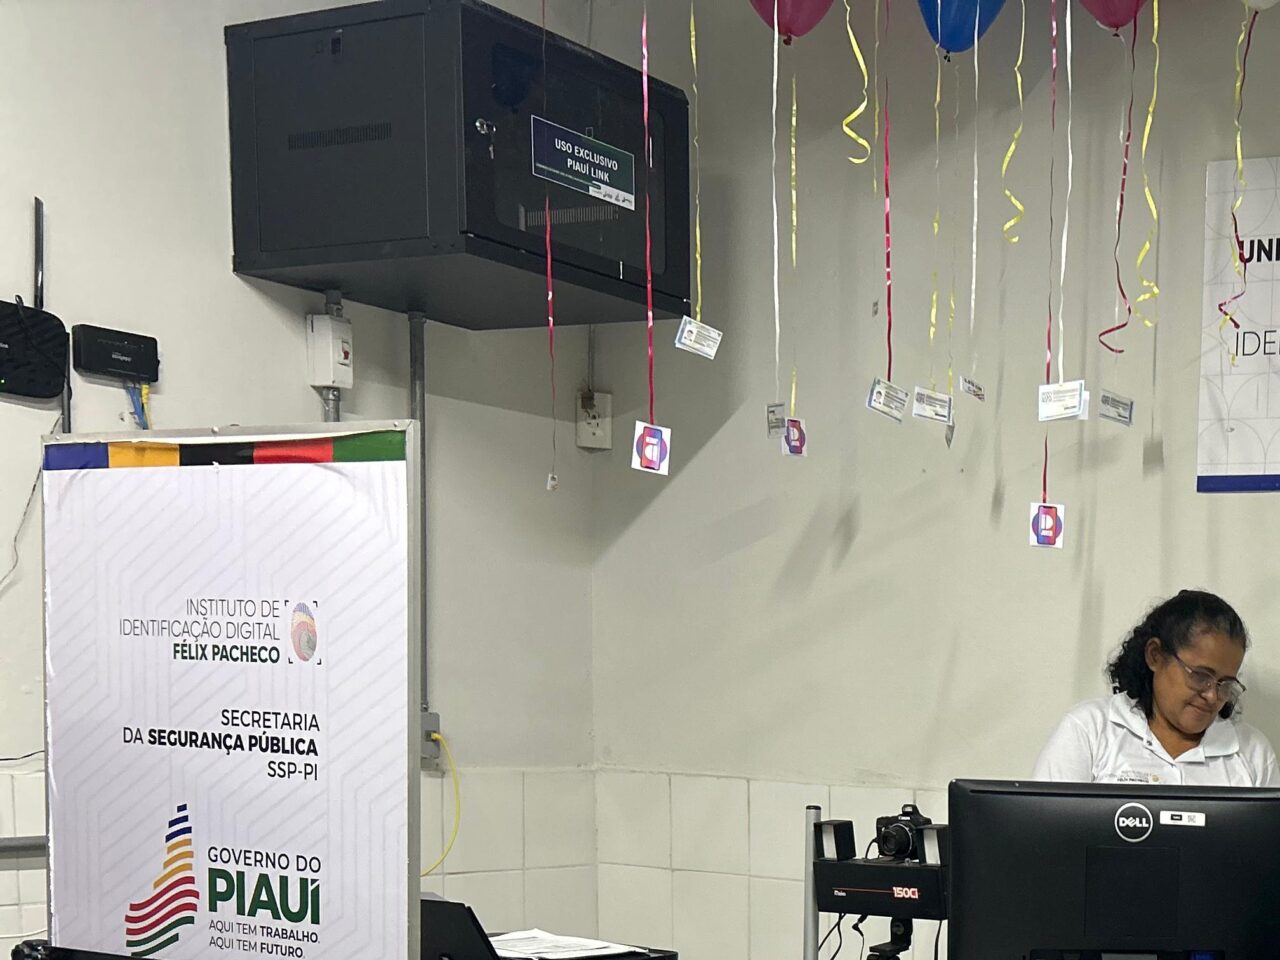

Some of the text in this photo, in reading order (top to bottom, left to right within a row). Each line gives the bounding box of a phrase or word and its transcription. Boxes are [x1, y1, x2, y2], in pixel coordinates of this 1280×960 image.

[555, 138, 573, 153] USO
[574, 146, 618, 171] EXCLUSIVO
[567, 158, 589, 175] PIAUÍ
[591, 167, 610, 183] LINK
[186, 598, 280, 618] INSTITUTO DE
[119, 617, 281, 643] IDENTIFICAÇÃO DIGITAL
[173, 639, 281, 664] FÉLIX PACHECO
[221, 708, 320, 732] SECRETARIA
[123, 727, 319, 756] DA SEGURANÇA PÚBLICA
[267, 760, 318, 781] SSP-PI
[1118, 816, 1149, 828] DELL
[208, 846, 321, 873] GOVERNO DO
[208, 867, 321, 925] PIAUÍ
[209, 919, 234, 934] AQUI
[236, 922, 257, 936] TEM
[209, 936, 234, 952] AQUI
[236, 940, 257, 953] TEM
